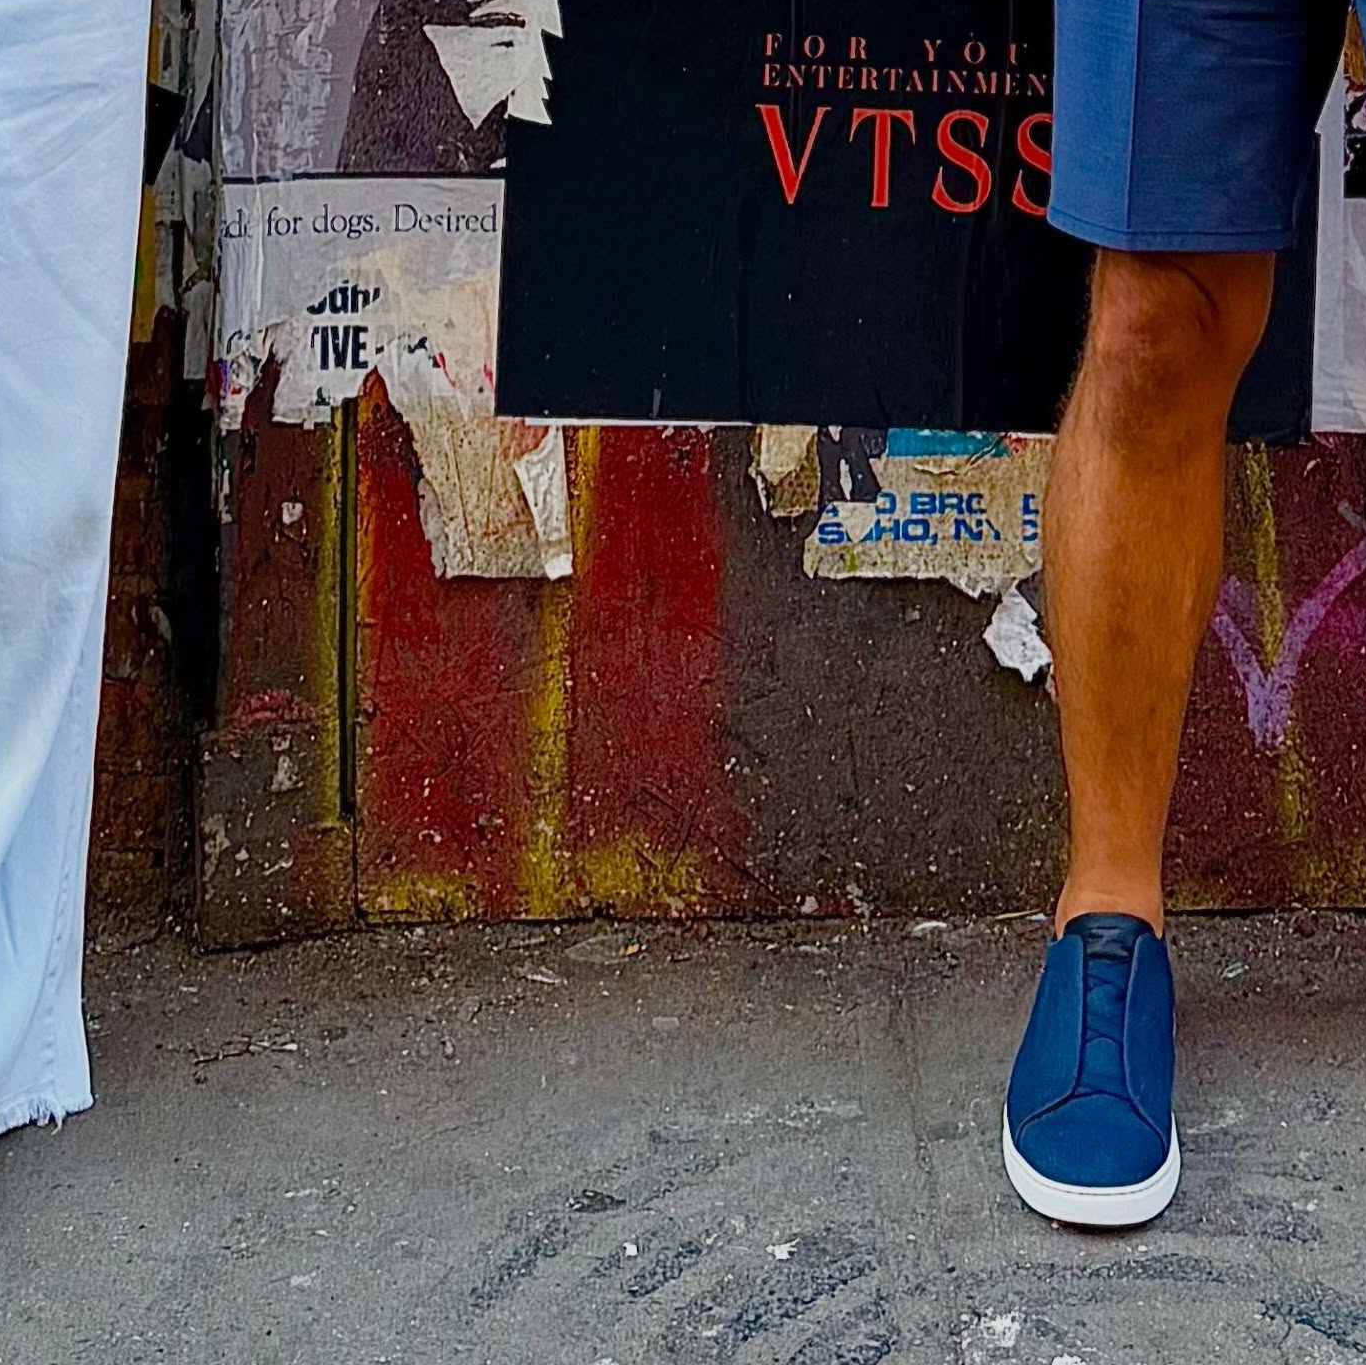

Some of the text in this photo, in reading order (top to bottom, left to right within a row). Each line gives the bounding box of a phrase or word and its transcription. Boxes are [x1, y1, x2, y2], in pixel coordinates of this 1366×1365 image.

[765, 33, 1028, 65] FOR YOU
[763, 63, 1048, 97] ENTERTAINMEN
[755, 103, 1054, 215] VTSS
[266, 206, 303, 237] for
[312, 203, 380, 240] dogs.
[393, 203, 498, 234] Desired
[817, 518, 938, 546] SHO,
